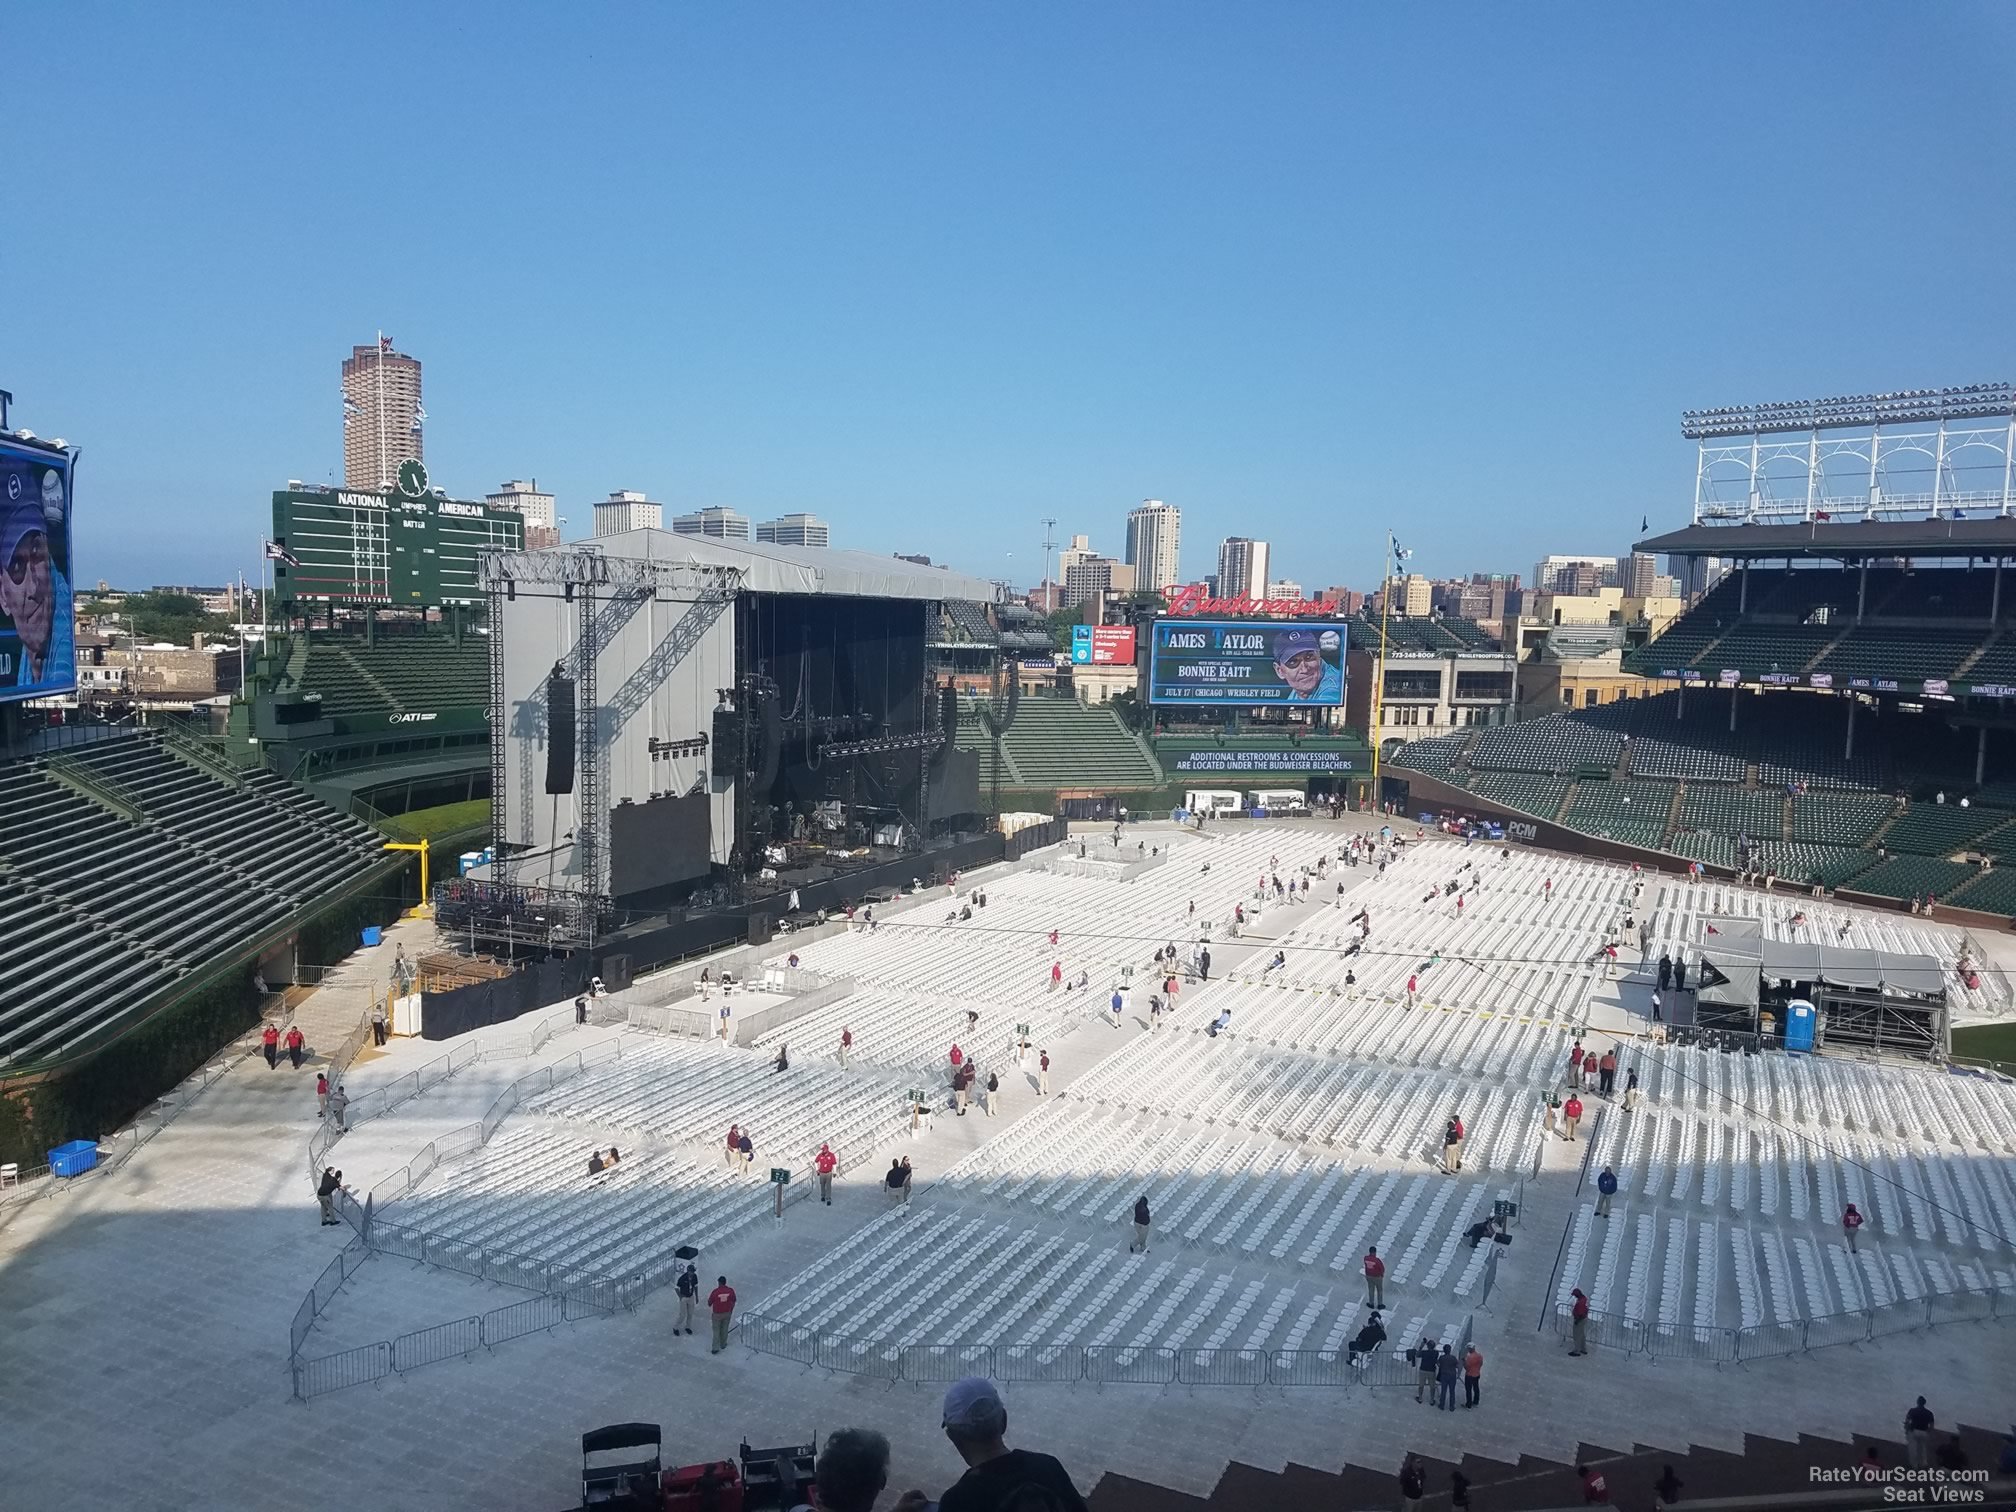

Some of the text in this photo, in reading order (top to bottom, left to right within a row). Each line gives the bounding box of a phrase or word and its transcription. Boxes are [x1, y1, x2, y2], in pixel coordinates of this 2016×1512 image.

[338, 492, 389, 509] NATIONAL
[401, 501, 427, 511] UMPIRES
[438, 502, 484, 517] AMERICAN
[402, 519, 426, 529] BATTER
[1161, 584, 1339, 616] Budweiser
[1161, 628, 1265, 650] JAMES TAYLOR
[1178, 665, 1252, 678] BONNIE RAITT
[1659, 667, 1678, 677] JAMES
[1848, 675, 1898, 689] JAMES TAYLOR
[1164, 688, 1191, 697] JULY 17
[1194, 688, 1223, 697] CHICAGO
[1227, 689, 1281, 698] WRIGLEY FIELD
[1971, 685, 1997, 694] BONNIE
[1998, 687, 2016, 696] RAIT
[401, 713, 421, 722] ATI
[1190, 752, 1340, 761] ADDITIONAL RESTROOMS & CONCESSIONS
[1176, 761, 1352, 770] ARE LOCATED UNDER THE BUDWEISER BLEACHERS
[1508, 821, 1537, 840] PCM
